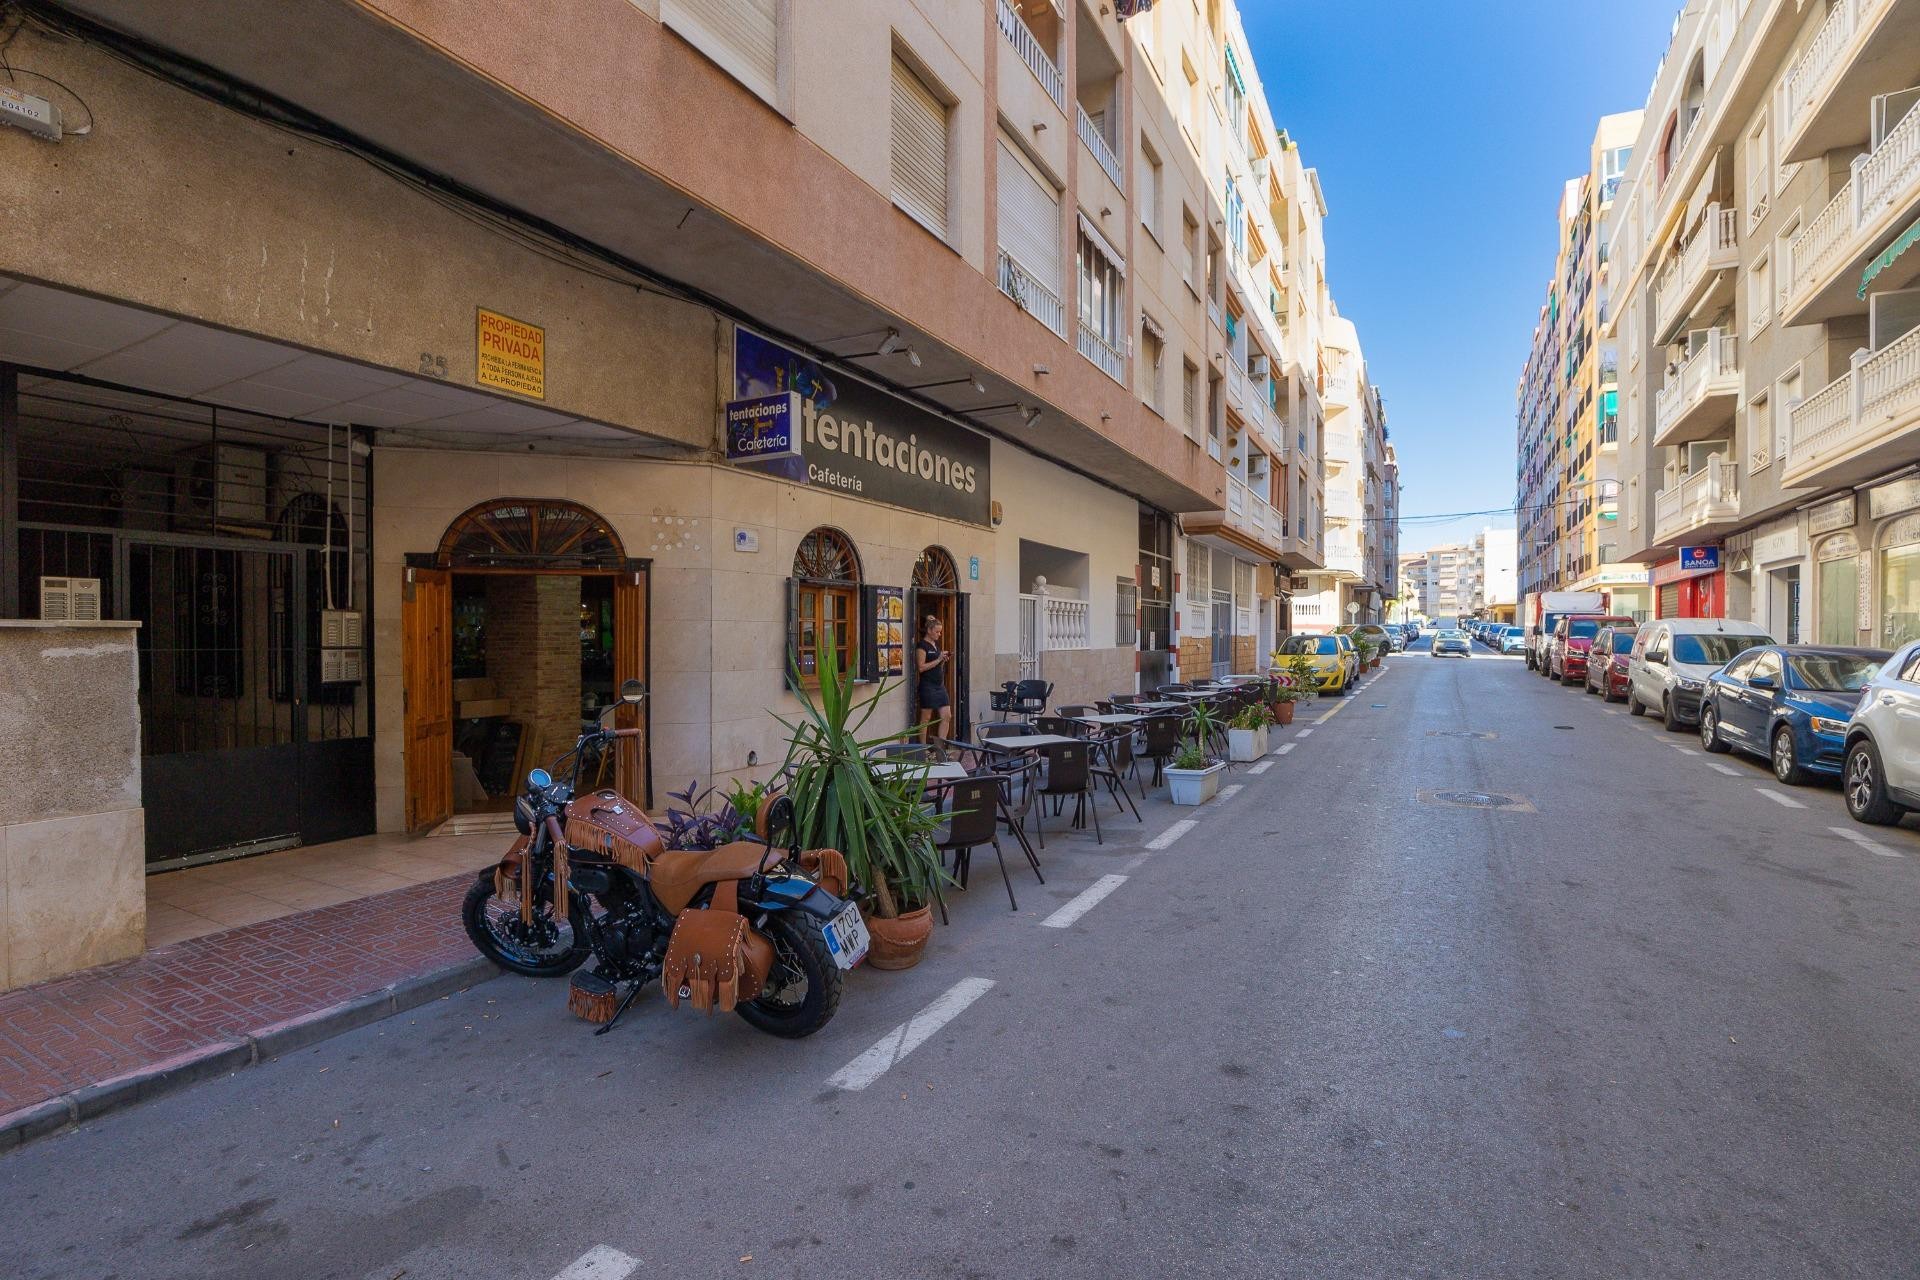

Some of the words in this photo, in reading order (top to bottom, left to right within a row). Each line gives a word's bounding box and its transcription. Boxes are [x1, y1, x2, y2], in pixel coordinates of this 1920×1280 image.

[480, 313, 542, 345] PROPIEDAD
[482, 331, 541, 362] PRIVADA
[419, 351, 448, 378] 25
[481, 372, 487, 380] A
[488, 372, 499, 382] LA
[500, 376, 542, 394] PROPIEDAD
[729, 401, 788, 422] tentaciones
[737, 434, 787, 452] Cafetería
[803, 398, 976, 494] tentaciones
[808, 463, 863, 493] Cafetería
[833, 907, 860, 939] 1702
[840, 929, 860, 958] MWP
